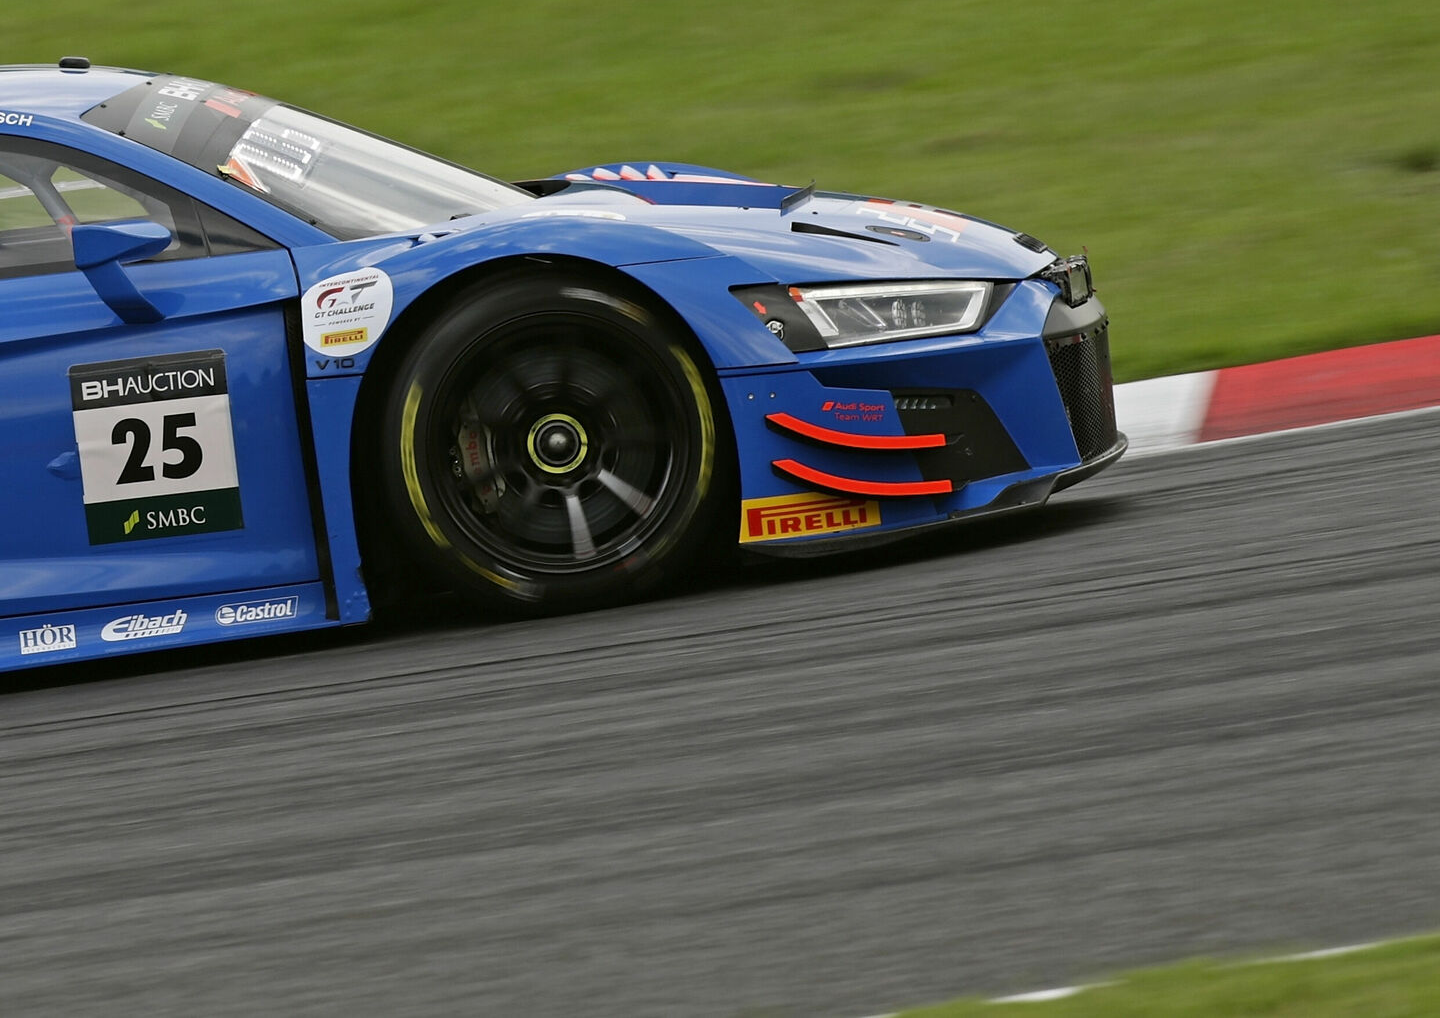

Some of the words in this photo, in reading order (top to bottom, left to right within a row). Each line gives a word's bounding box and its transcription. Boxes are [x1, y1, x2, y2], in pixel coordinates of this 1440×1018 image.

[319, 274, 379, 288] INTERCONTINENTAL
[314, 311, 327, 319] GT
[327, 302, 375, 317] CHALLENGE
[324, 330, 364, 345] PIRELLI
[834, 412, 860, 421] Team
[862, 413, 884, 422] WRT
[835, 402, 857, 410] Audi
[859, 403, 885, 412] Sport
[111, 412, 203, 485] 25
[146, 506, 206, 530] SMBC
[746, 498, 867, 538] PIRELLI
[235, 600, 293, 622] Castrol
[21, 624, 74, 648] HÖR
[100, 609, 188, 642] Eibach
